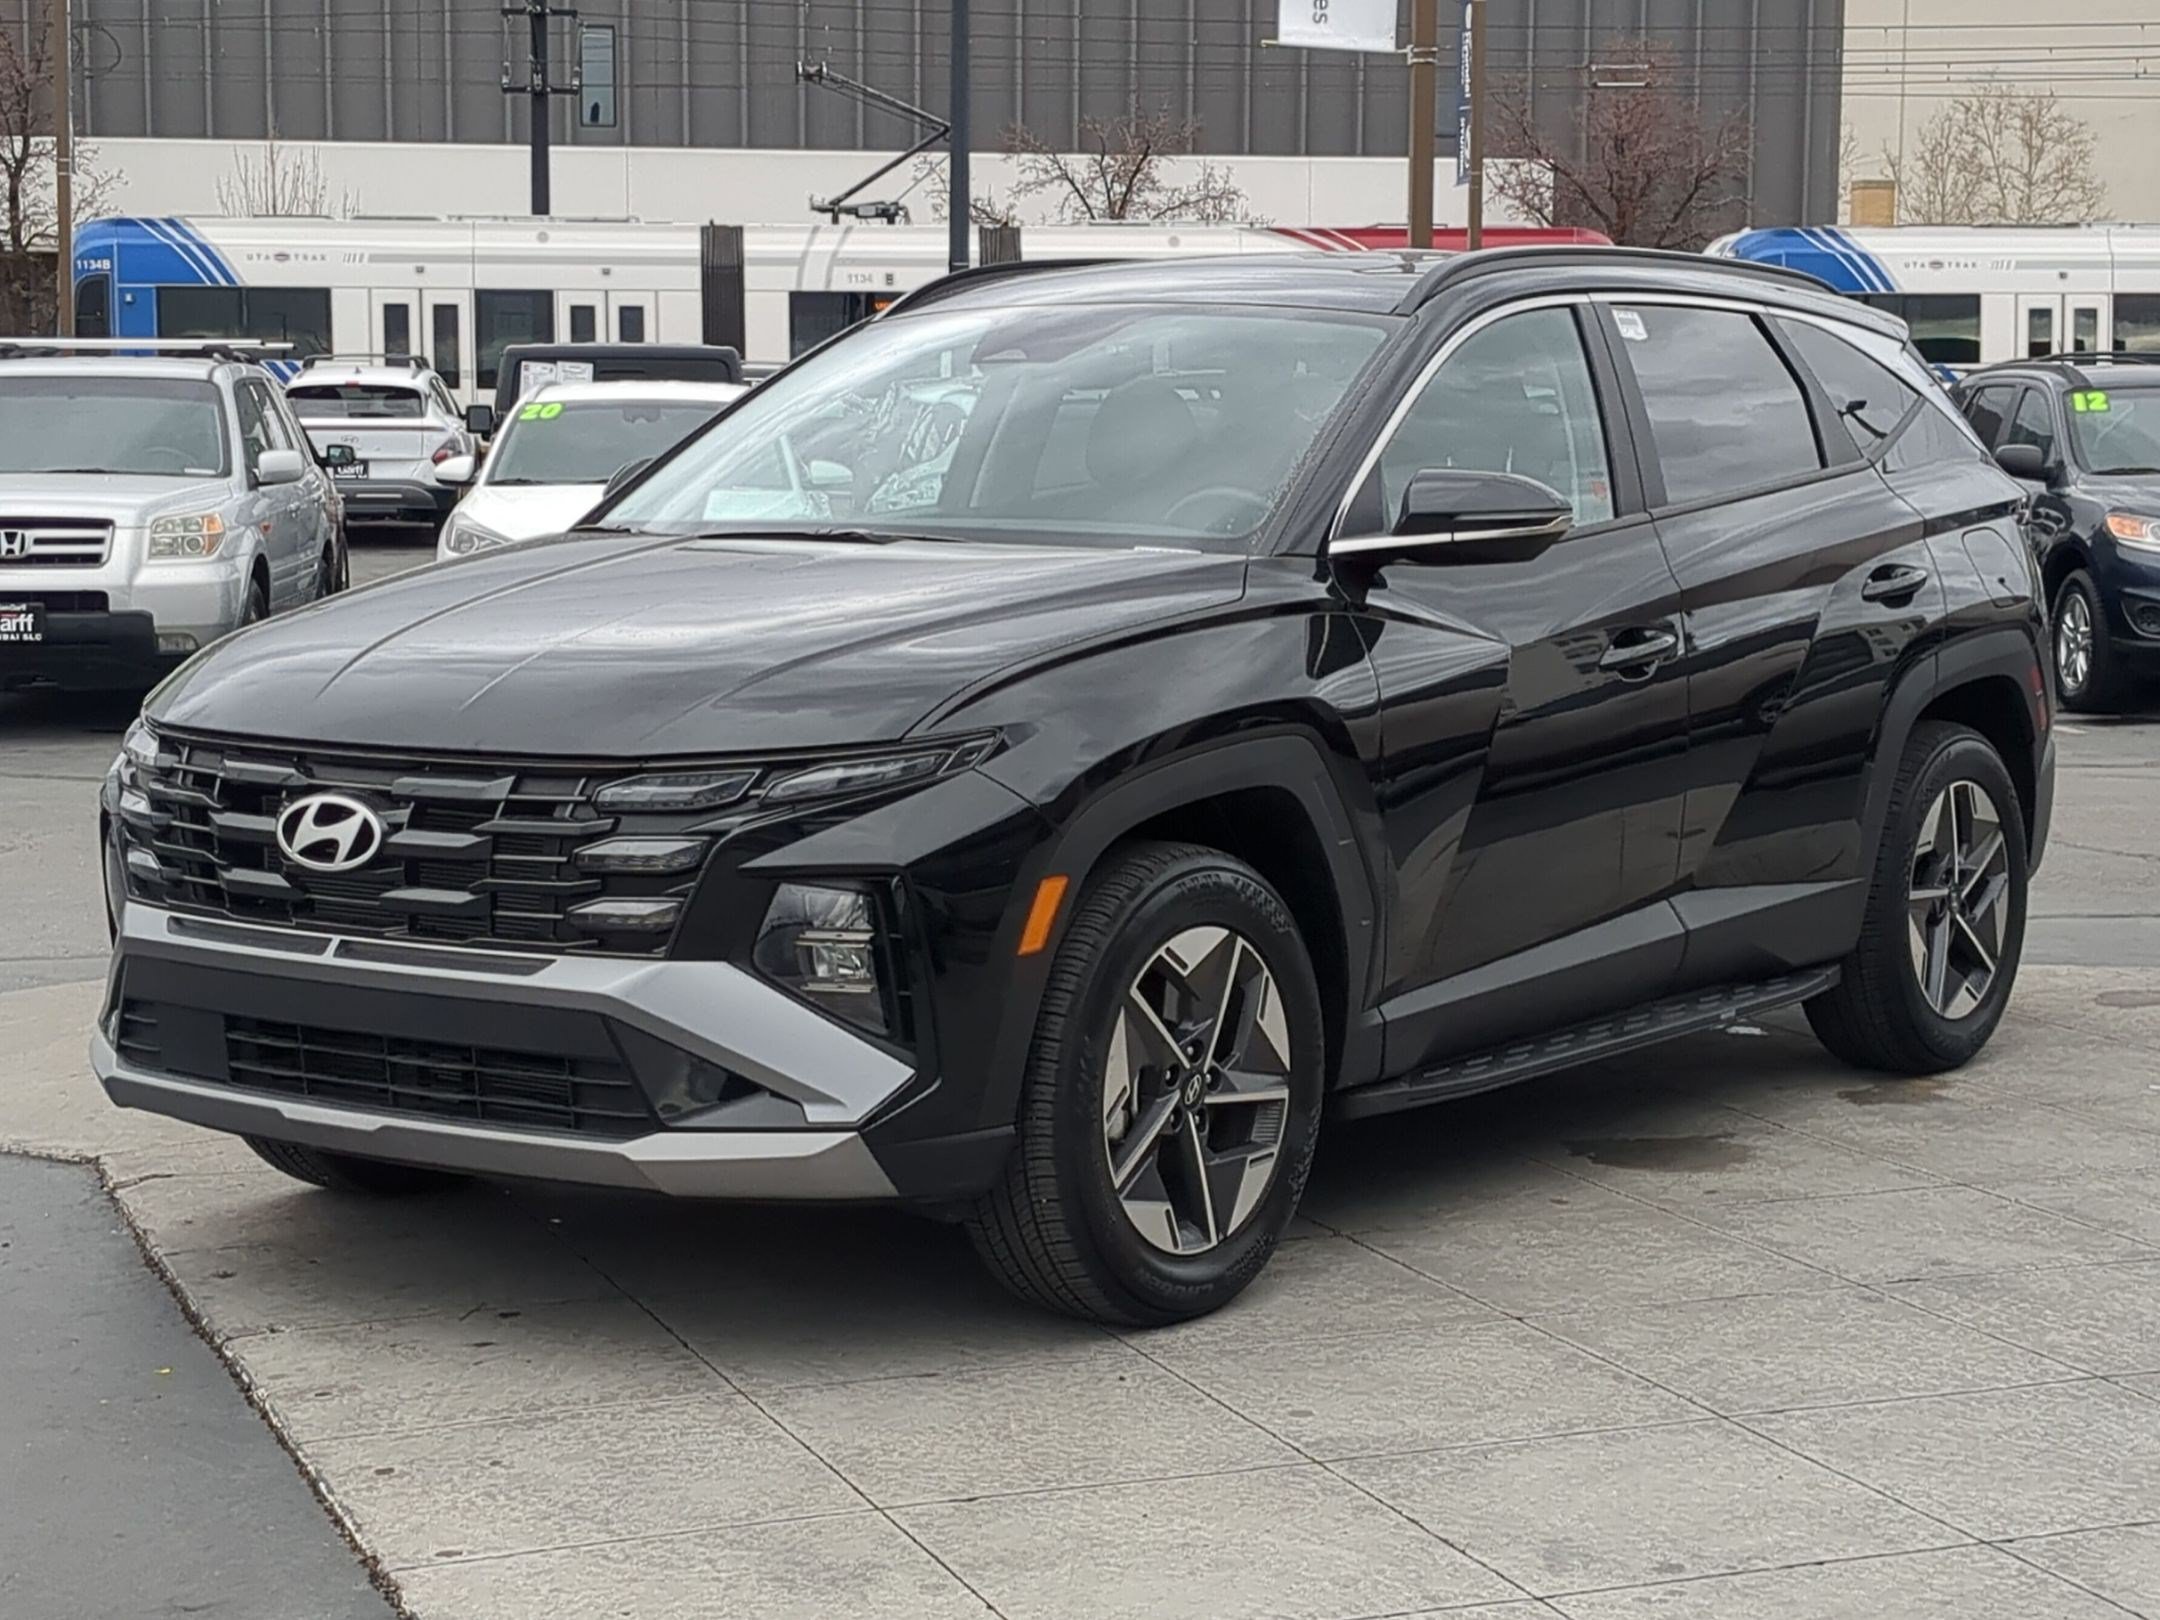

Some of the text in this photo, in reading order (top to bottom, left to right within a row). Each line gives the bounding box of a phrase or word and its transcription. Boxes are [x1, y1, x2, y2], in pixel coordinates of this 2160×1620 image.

[76, 258, 111, 271] 1134B
[246, 253, 271, 261] UTA
[2072, 391, 2109, 412] 12
[519, 402, 563, 421] 20
[0, 612, 35, 633] arff
